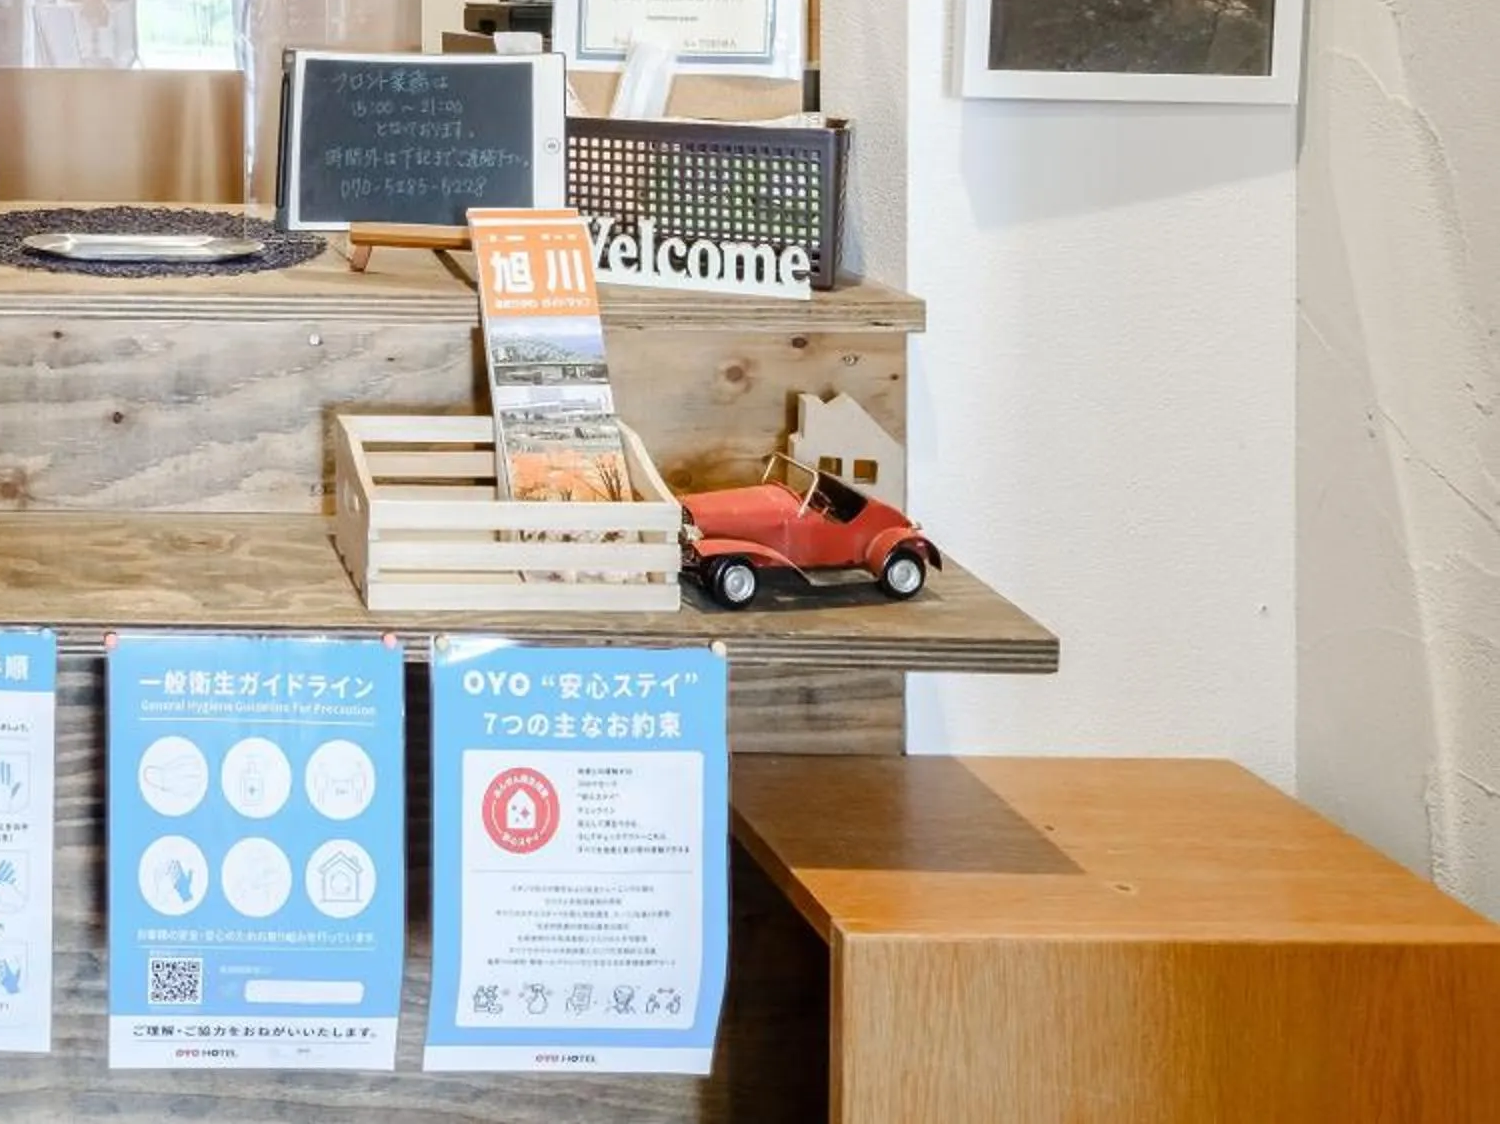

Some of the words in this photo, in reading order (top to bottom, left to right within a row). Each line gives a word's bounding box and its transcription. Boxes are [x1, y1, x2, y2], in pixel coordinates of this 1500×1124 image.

[490, 248, 587, 294] 旭川
[139, 669, 374, 700] 一般衛生ガイドライン
[463, 670, 531, 698] OYO
[483, 711, 682, 738] 7つの主なお約束
